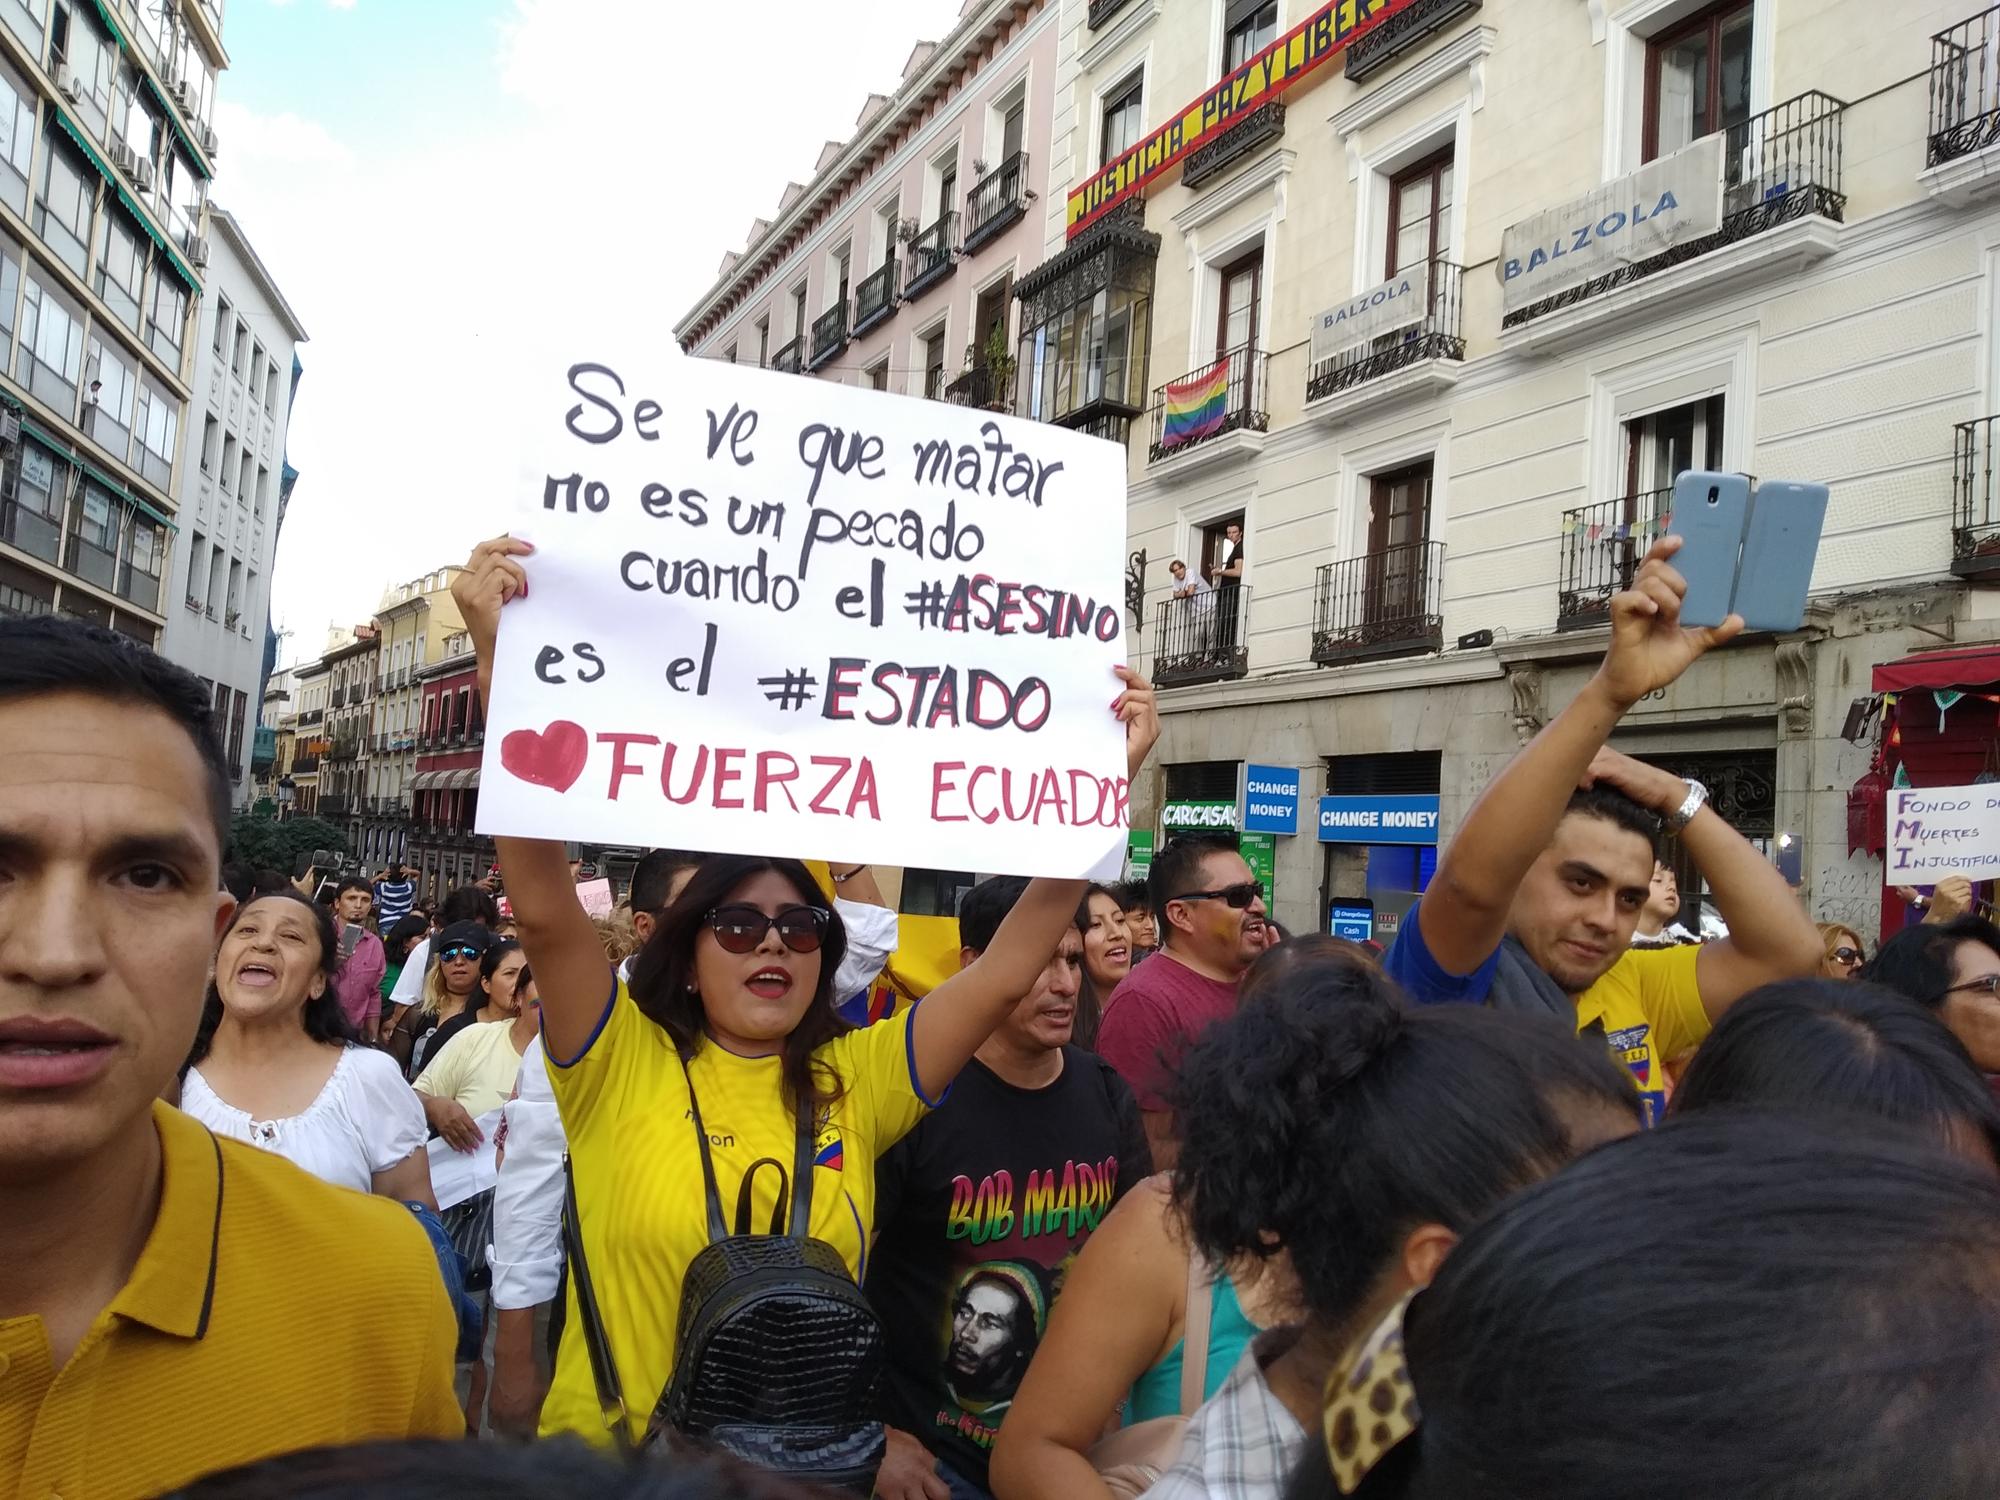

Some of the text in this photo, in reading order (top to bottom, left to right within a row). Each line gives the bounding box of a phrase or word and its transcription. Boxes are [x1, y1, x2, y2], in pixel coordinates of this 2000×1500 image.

[1202, 67, 1252, 135] PAZ
[1262, 47, 1276, 93] Y
[1284, 0, 1392, 80] LIBER
[1504, 190, 1679, 282] BALZOLA
[1323, 280, 1411, 329] BALZOLA
[565, 362, 1065, 507] Se ve que matar
[543, 472, 985, 580] no es un pecado
[620, 548, 1119, 642] cuando el #ASESINO
[534, 622, 1052, 732] es el #ESTADO
[595, 731, 1130, 830] FUERZA ECUADOR
[1247, 780, 1298, 797] CHANGE
[1249, 804, 1293, 818] MONEY
[1897, 793, 2000, 815] FONDO D
[1320, 810, 1438, 829] CHANGE MONEY
[1894, 819, 1980, 843] MUERTES
[1893, 847, 2000, 870] INJUSTIFICA
[1343, 926, 1360, 935] Cash
[946, 1169, 1015, 1245] BOB
